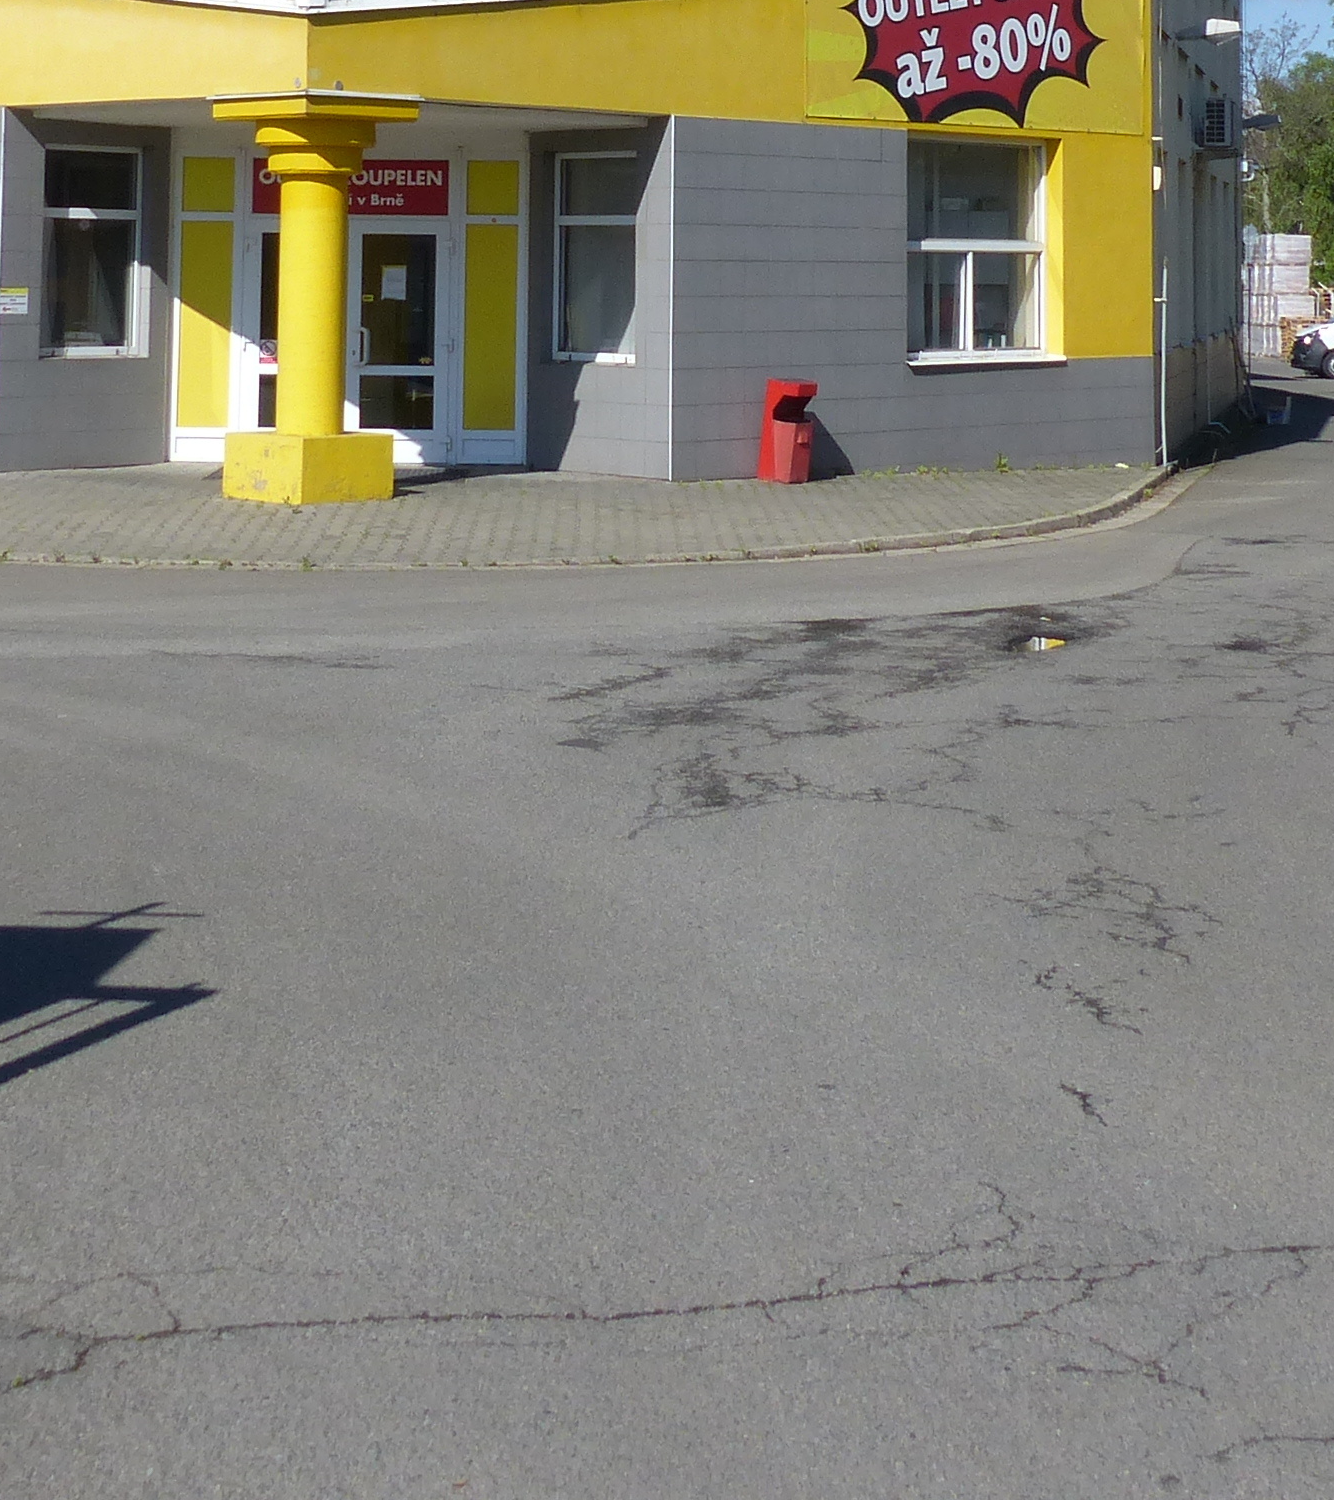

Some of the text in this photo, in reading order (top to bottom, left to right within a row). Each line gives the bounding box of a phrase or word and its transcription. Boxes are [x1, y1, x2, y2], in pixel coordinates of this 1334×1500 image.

[896, 3, 1072, 99] až -80%
[348, 169, 443, 186] OUPELEN
[370, 193, 405, 207] Brně
